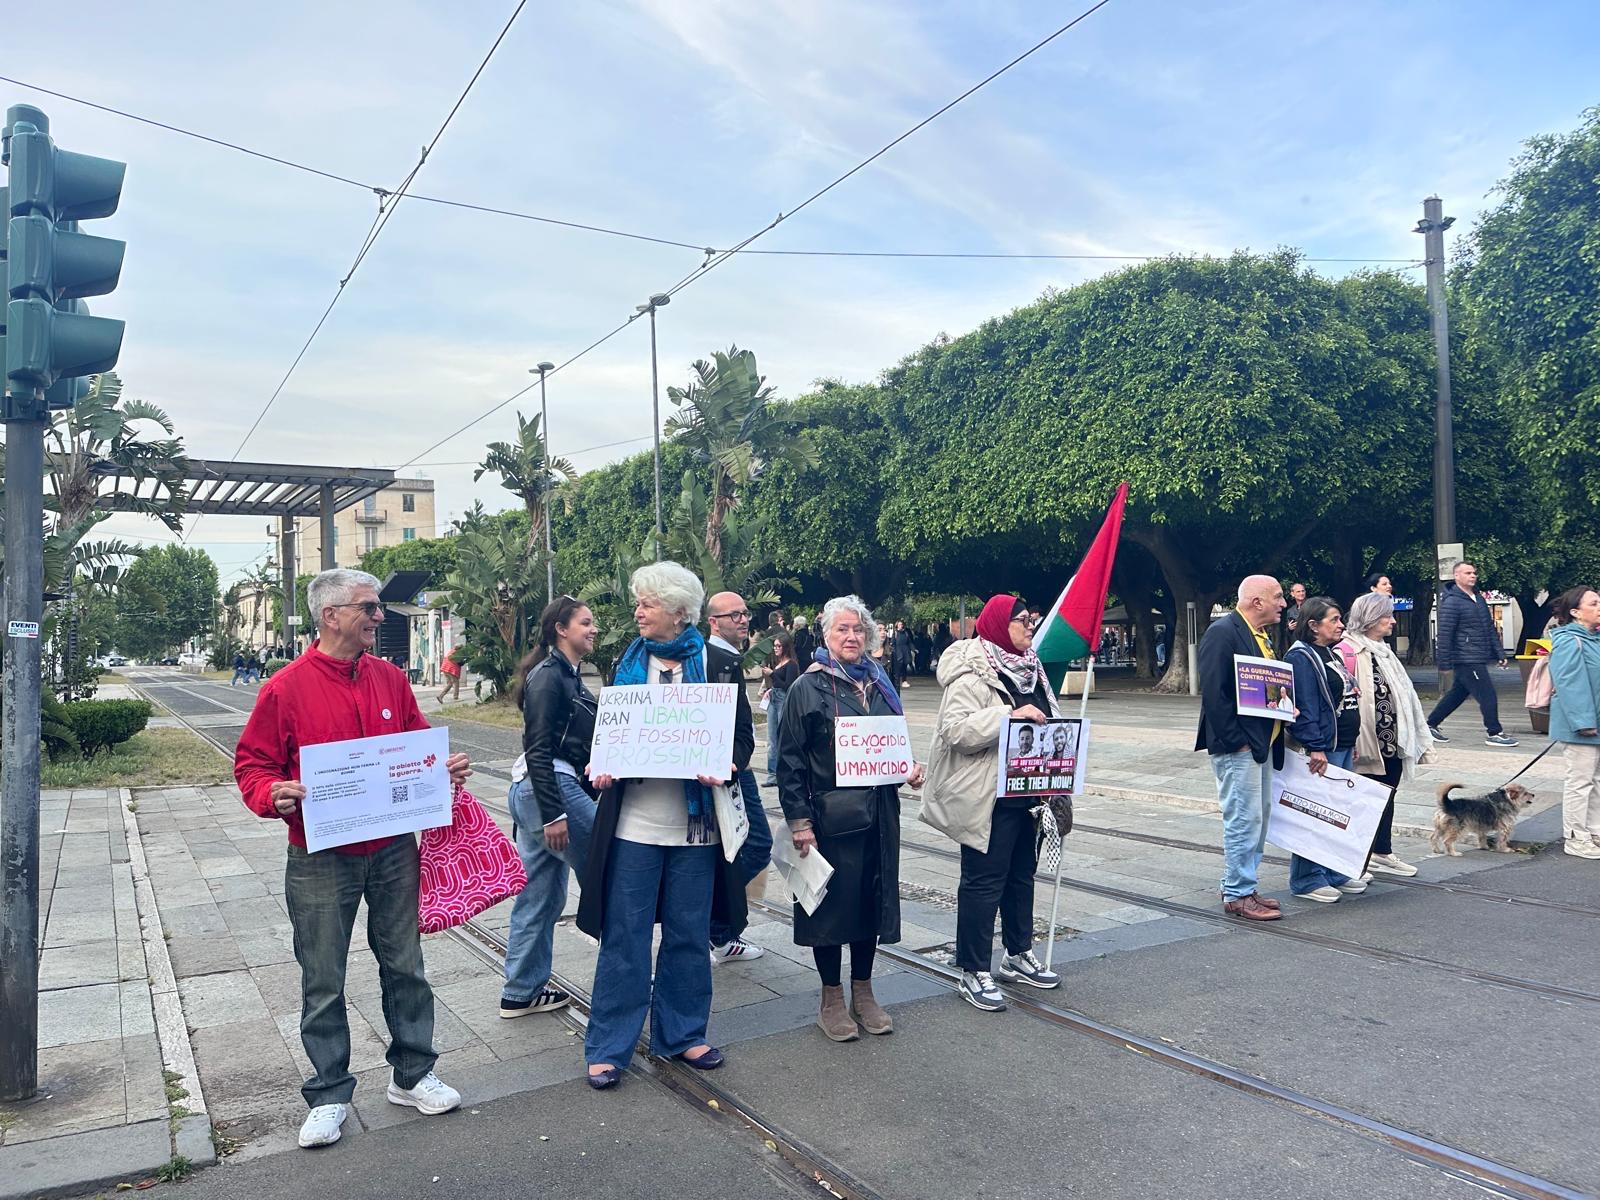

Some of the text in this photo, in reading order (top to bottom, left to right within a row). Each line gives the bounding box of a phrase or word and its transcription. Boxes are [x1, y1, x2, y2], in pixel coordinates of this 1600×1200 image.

[1240, 673, 1264, 681] CONTRO
[599, 686, 732, 706] UCRAINA PALESTINA
[598, 705, 707, 726] IRAN LIBANO
[594, 733, 602, 745] E
[608, 729, 631, 744] SE
[638, 728, 711, 745] FOSSIMO
[839, 734, 906, 747] GENOCIDIO
[837, 761, 908, 776] UMANICIDIO
[1007, 775, 1073, 791] FREE THEM NOW!
[1282, 792, 1309, 807] PALAZZO
[1309, 802, 1327, 815] DELLA
[1328, 811, 1347, 823] MODA
